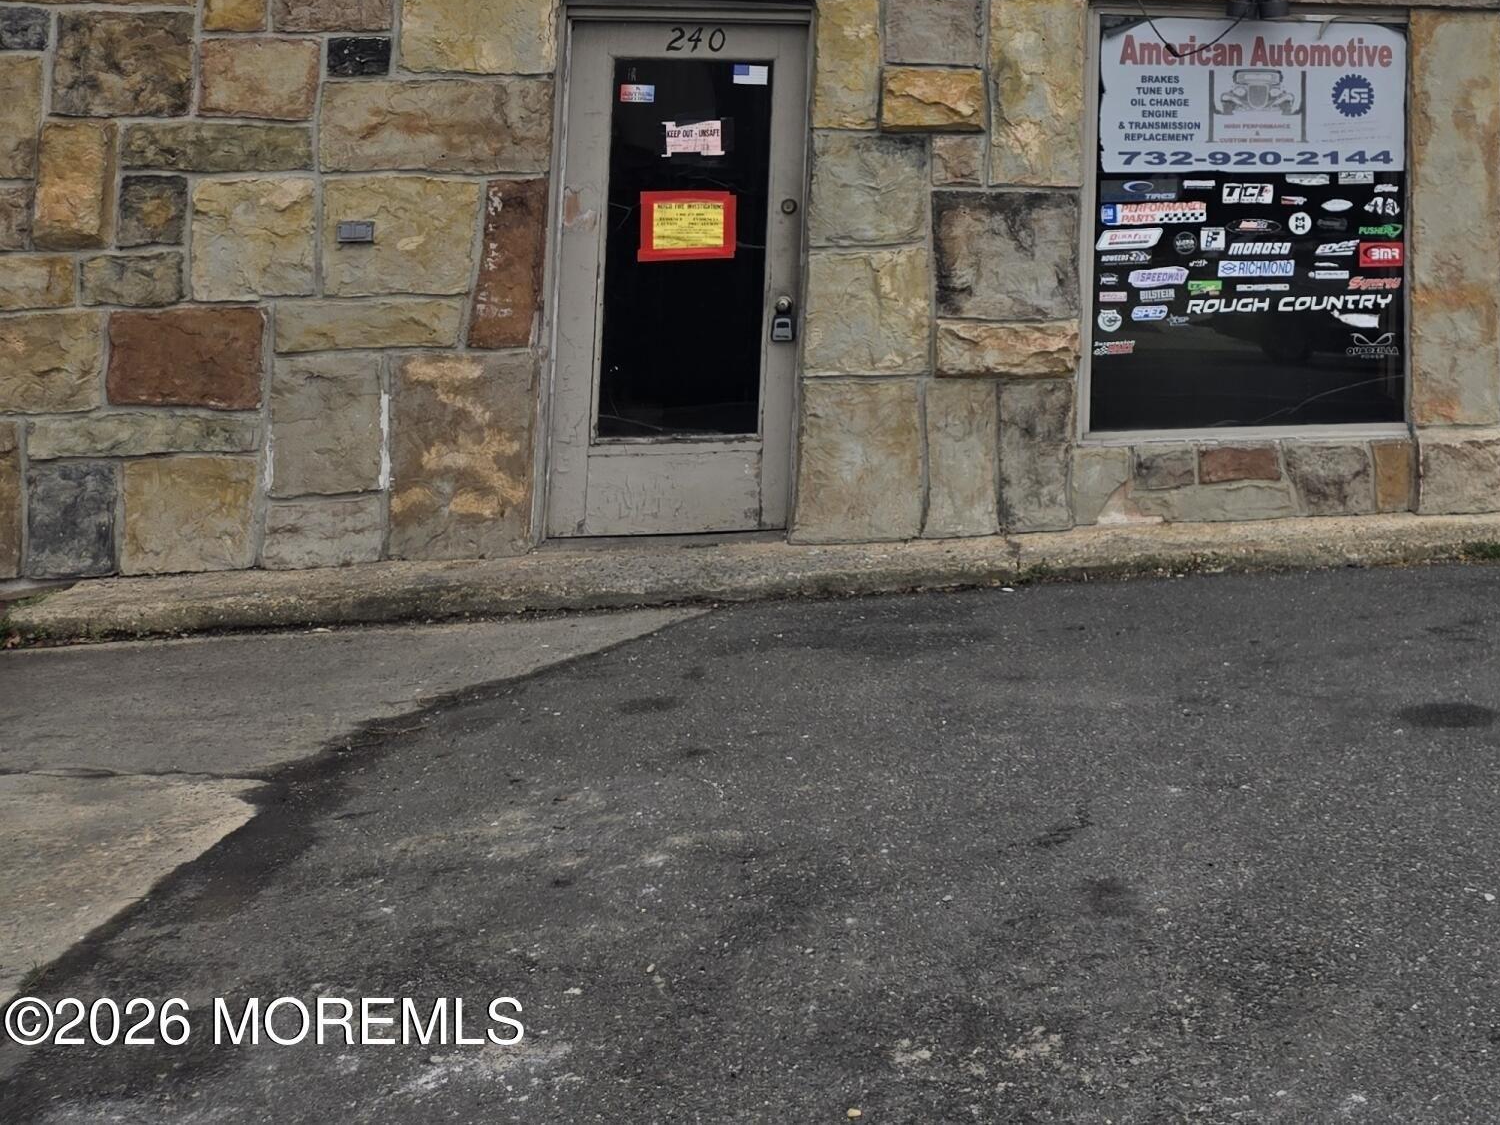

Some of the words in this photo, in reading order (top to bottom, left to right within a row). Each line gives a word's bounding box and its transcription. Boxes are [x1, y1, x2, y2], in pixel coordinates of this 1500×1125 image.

[666, 27, 726, 52] 240
[1119, 34, 1243, 67] American
[1250, 36, 1393, 68] Automotive
[1141, 75, 1180, 84] BRAKES
[1136, 86, 1162, 95] TUNE
[1165, 87, 1185, 95] UPS
[1337, 88, 1369, 104] ASE
[1130, 98, 1146, 107] OIL
[1149, 98, 1190, 107] CHANGE
[1141, 109, 1179, 118] ENGINE
[1118, 121, 1125, 130] &
[1128, 121, 1201, 130] TRANSMISSION
[667, 129, 681, 138] KEEP
[682, 129, 694, 138] OUT
[1124, 133, 1195, 142] REPLACEMENT
[1117, 150, 1394, 166] 732-920-2144
[1120, 201, 1206, 213] PERFORMANCE
[1121, 214, 1157, 223] PARTS
[1238, 261, 1293, 275] RICHMOND
[1140, 271, 1185, 282] SPEEDWAY
[1140, 288, 1175, 301] BILSTEIN
[1187, 297, 1270, 314] ROUGH
[1277, 294, 1393, 312] COUNTRY
